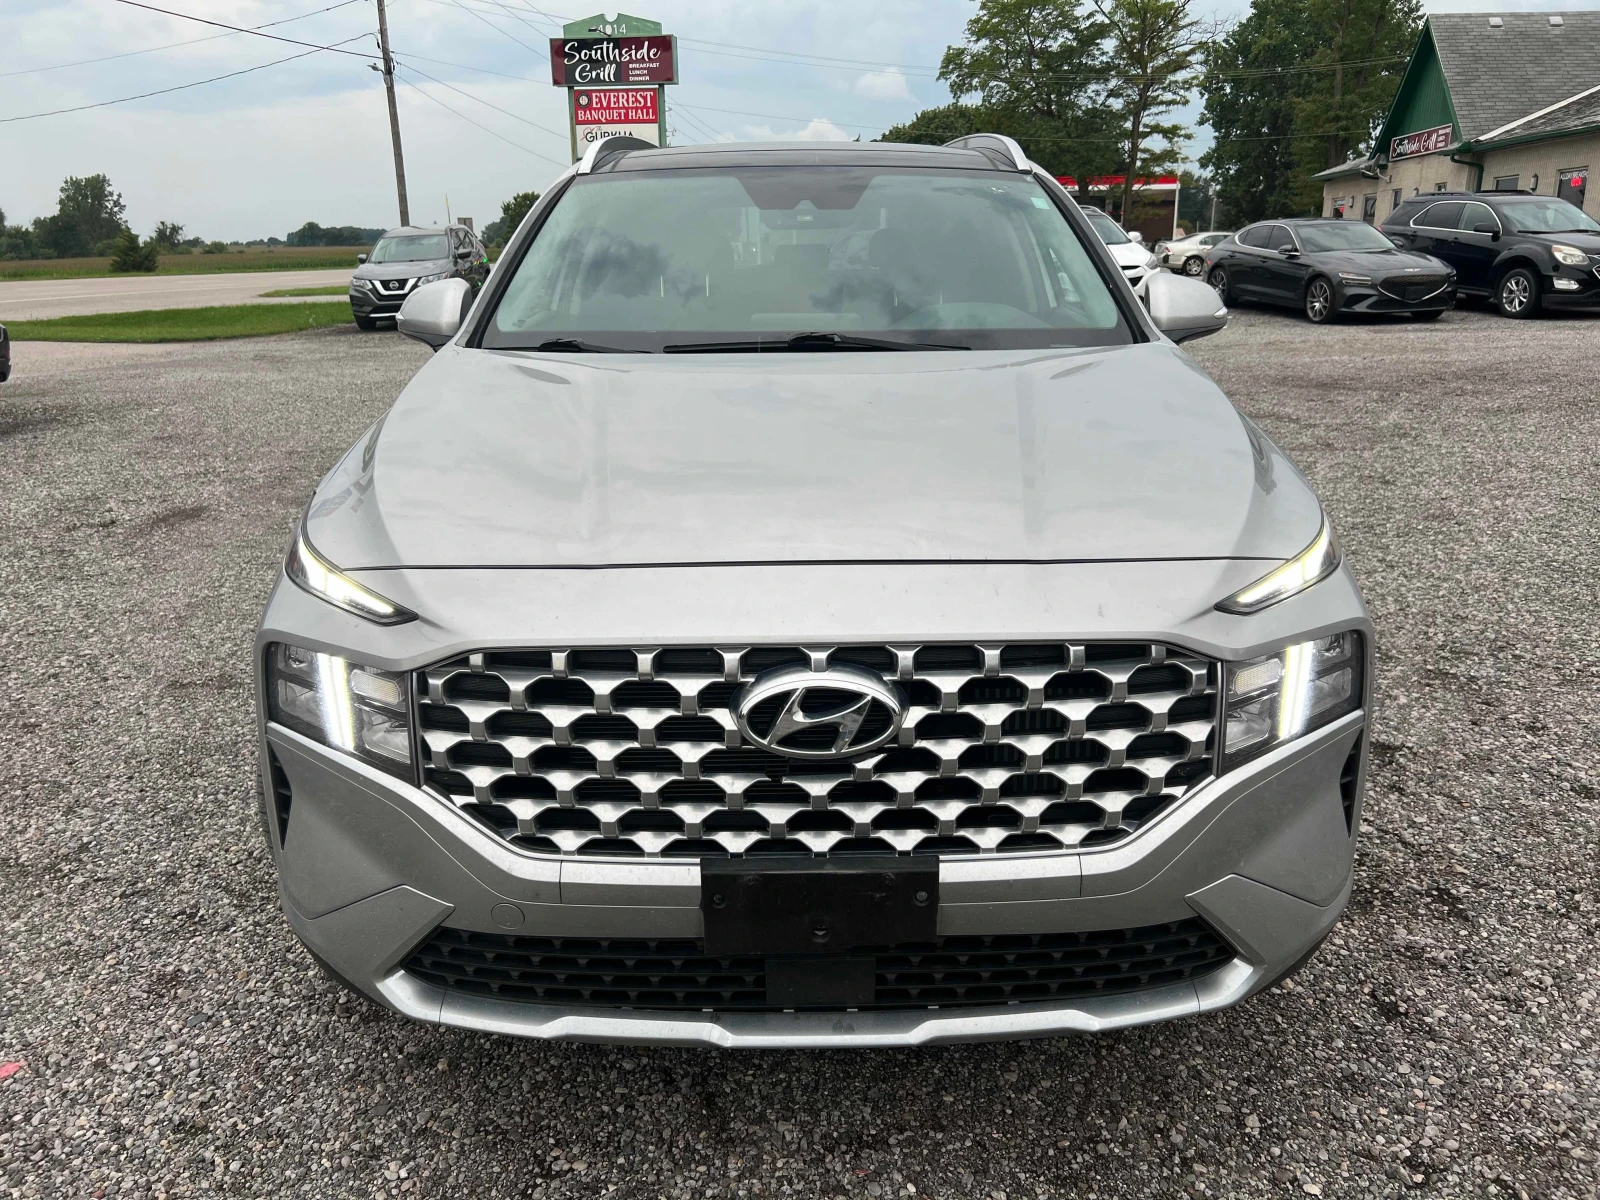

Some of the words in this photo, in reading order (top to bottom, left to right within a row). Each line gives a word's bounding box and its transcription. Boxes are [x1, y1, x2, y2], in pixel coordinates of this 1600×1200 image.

[597, 24, 627, 35] 4014
[564, 41, 660, 64] Southside
[574, 63, 617, 83] Grill
[592, 92, 653, 108] EVEREST
[577, 109, 626, 123] BANQUET
[628, 108, 656, 120] HALL
